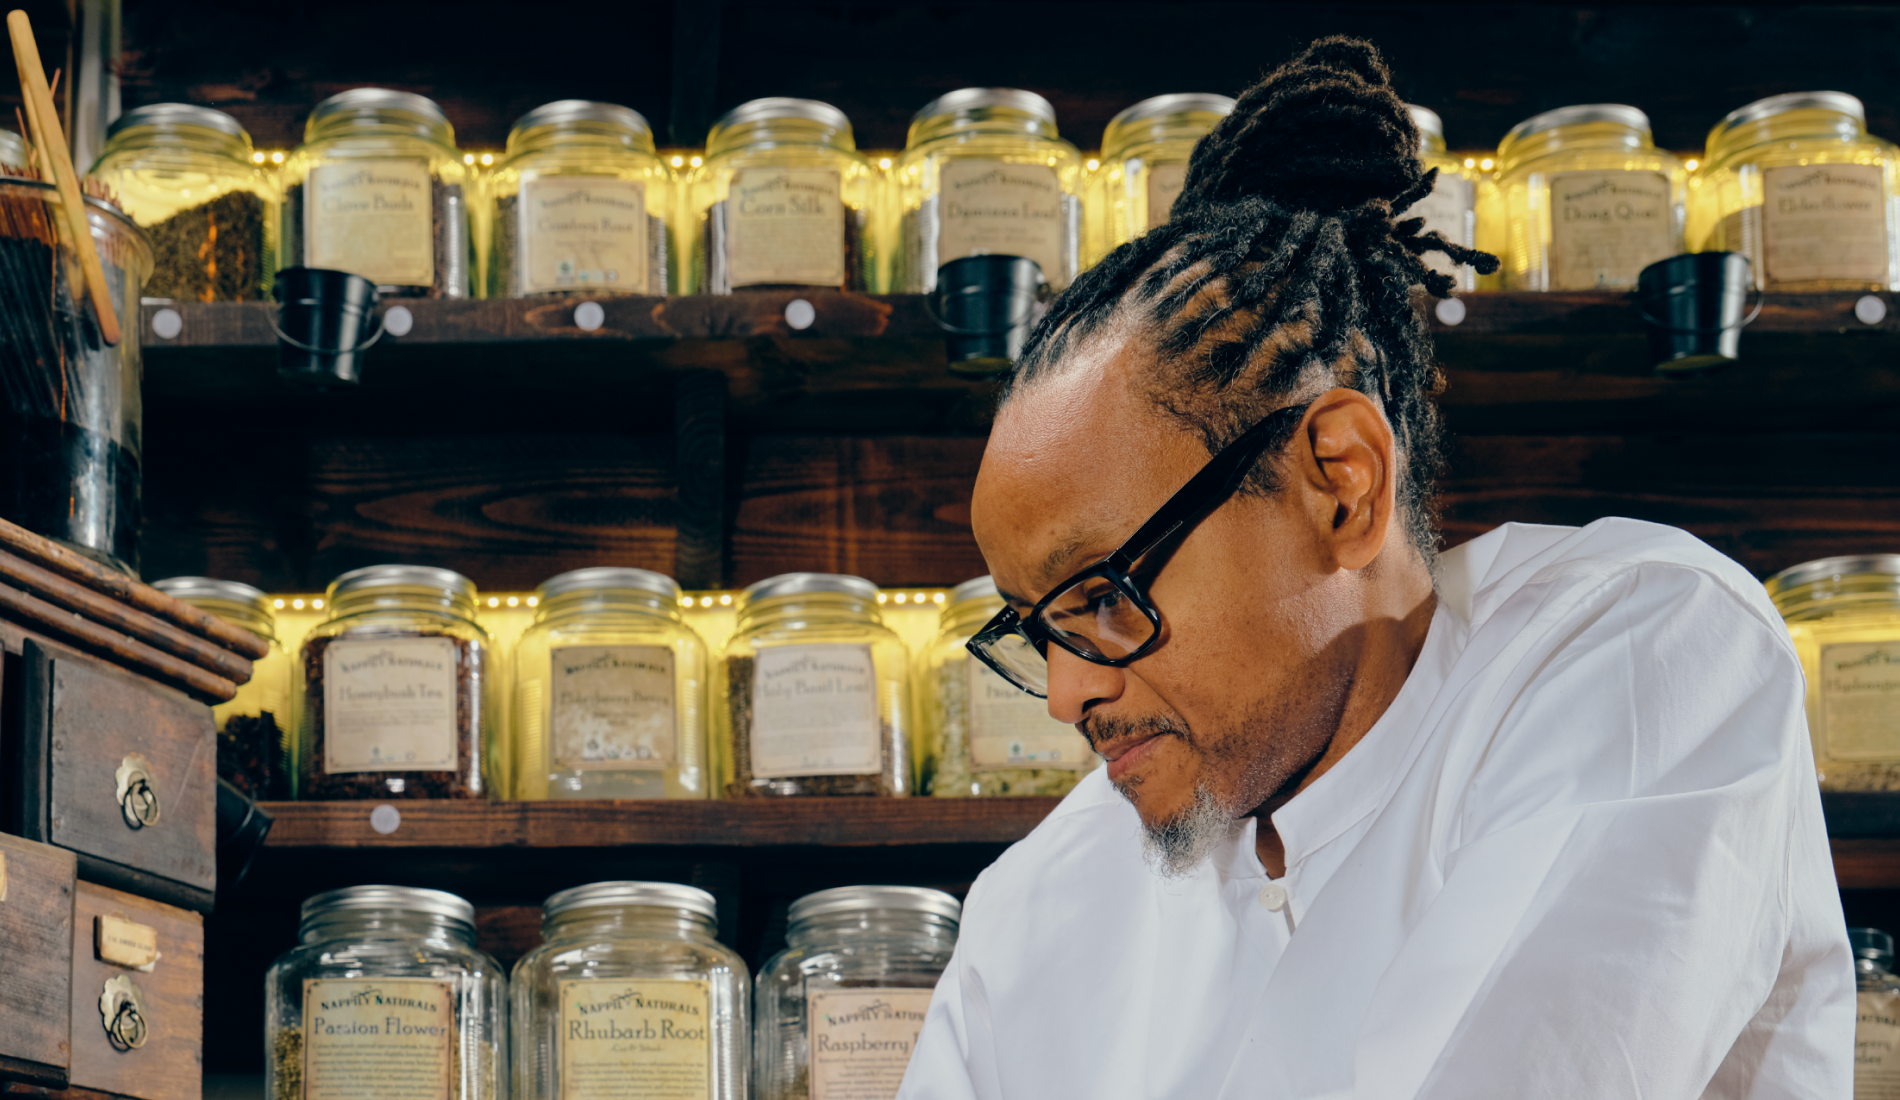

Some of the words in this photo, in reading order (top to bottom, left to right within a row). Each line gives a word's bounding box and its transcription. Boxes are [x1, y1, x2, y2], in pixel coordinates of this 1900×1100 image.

[739, 195, 786, 217] Corn
[789, 194, 826, 215] Silk
[321, 995, 369, 1011] NAPPILY
[375, 995, 437, 1012] NATURALS
[579, 999, 631, 1016] NAPPILY
[635, 998, 699, 1015] NATURALS
[313, 1017, 379, 1035] Passion
[385, 1016, 447, 1037] Flower
[828, 1011, 879, 1027] NAPPILY
[884, 1010, 926, 1022] NATUR
[568, 1019, 656, 1040] Rhubarb
[661, 1019, 705, 1040] Root
[817, 1033, 909, 1055] Raspberry
